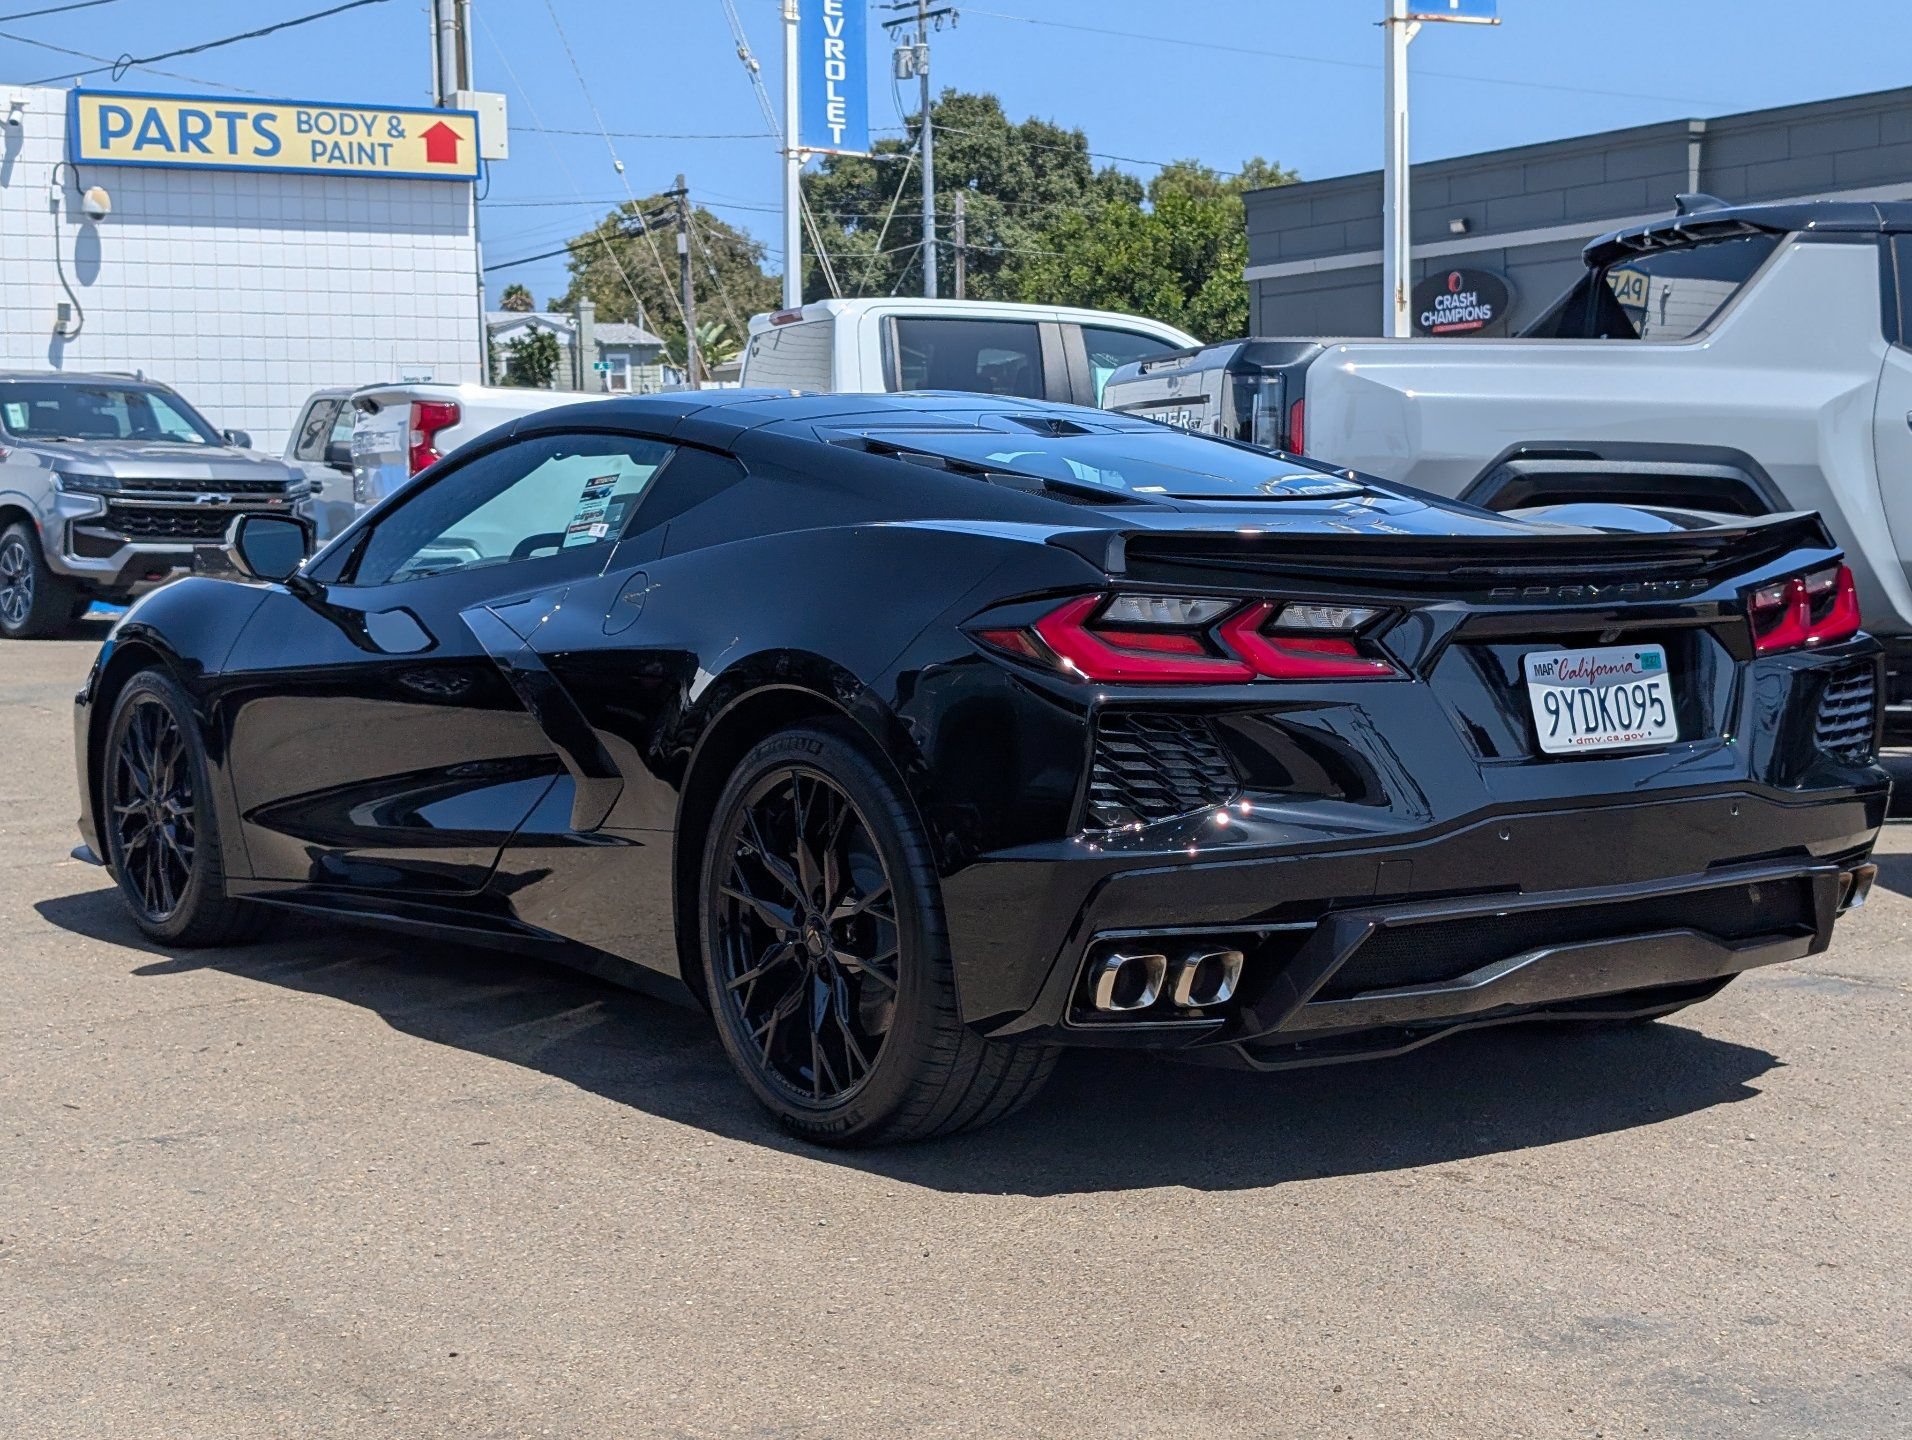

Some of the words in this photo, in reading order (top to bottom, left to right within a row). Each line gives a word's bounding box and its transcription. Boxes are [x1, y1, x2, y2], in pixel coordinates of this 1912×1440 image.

[98, 104, 282, 157] PARTS
[296, 110, 378, 137] BODY
[387, 115, 406, 139] &
[311, 139, 394, 166] PAINT
[1434, 291, 1477, 310] CRASH
[1420, 304, 1492, 326] CHAMPIONS
[1533, 662, 1555, 677] MAR
[1558, 656, 1642, 685] California
[1543, 683, 1666, 737] 9YDK095
[1576, 732, 1645, 745] dmv.ca.gov
